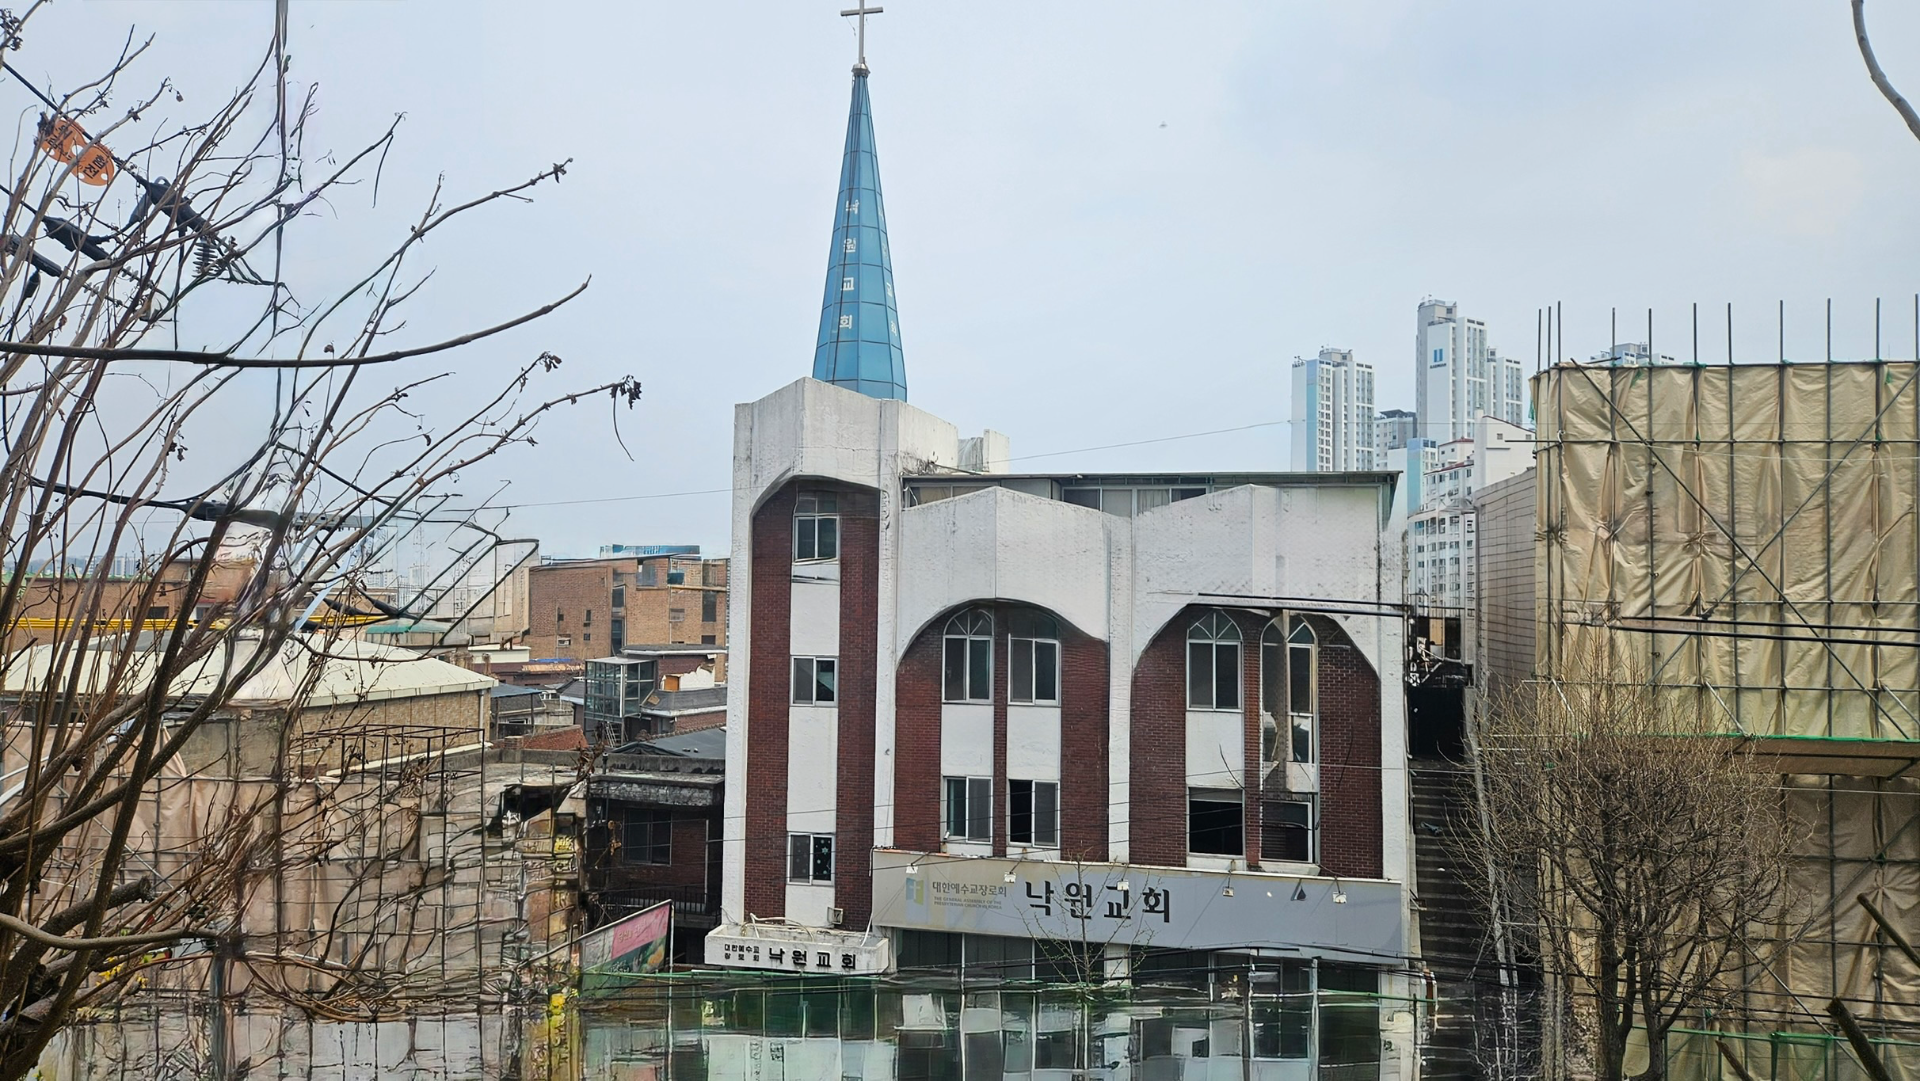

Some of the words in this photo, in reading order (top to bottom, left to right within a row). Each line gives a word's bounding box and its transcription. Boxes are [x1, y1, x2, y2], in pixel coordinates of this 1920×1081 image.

[932, 881, 1007, 898] 대한예수교장로회
[1025, 880, 1170, 924] 낙원교회
[724, 943, 760, 954] 대한예수교
[768, 947, 857, 970] 낙원교회
